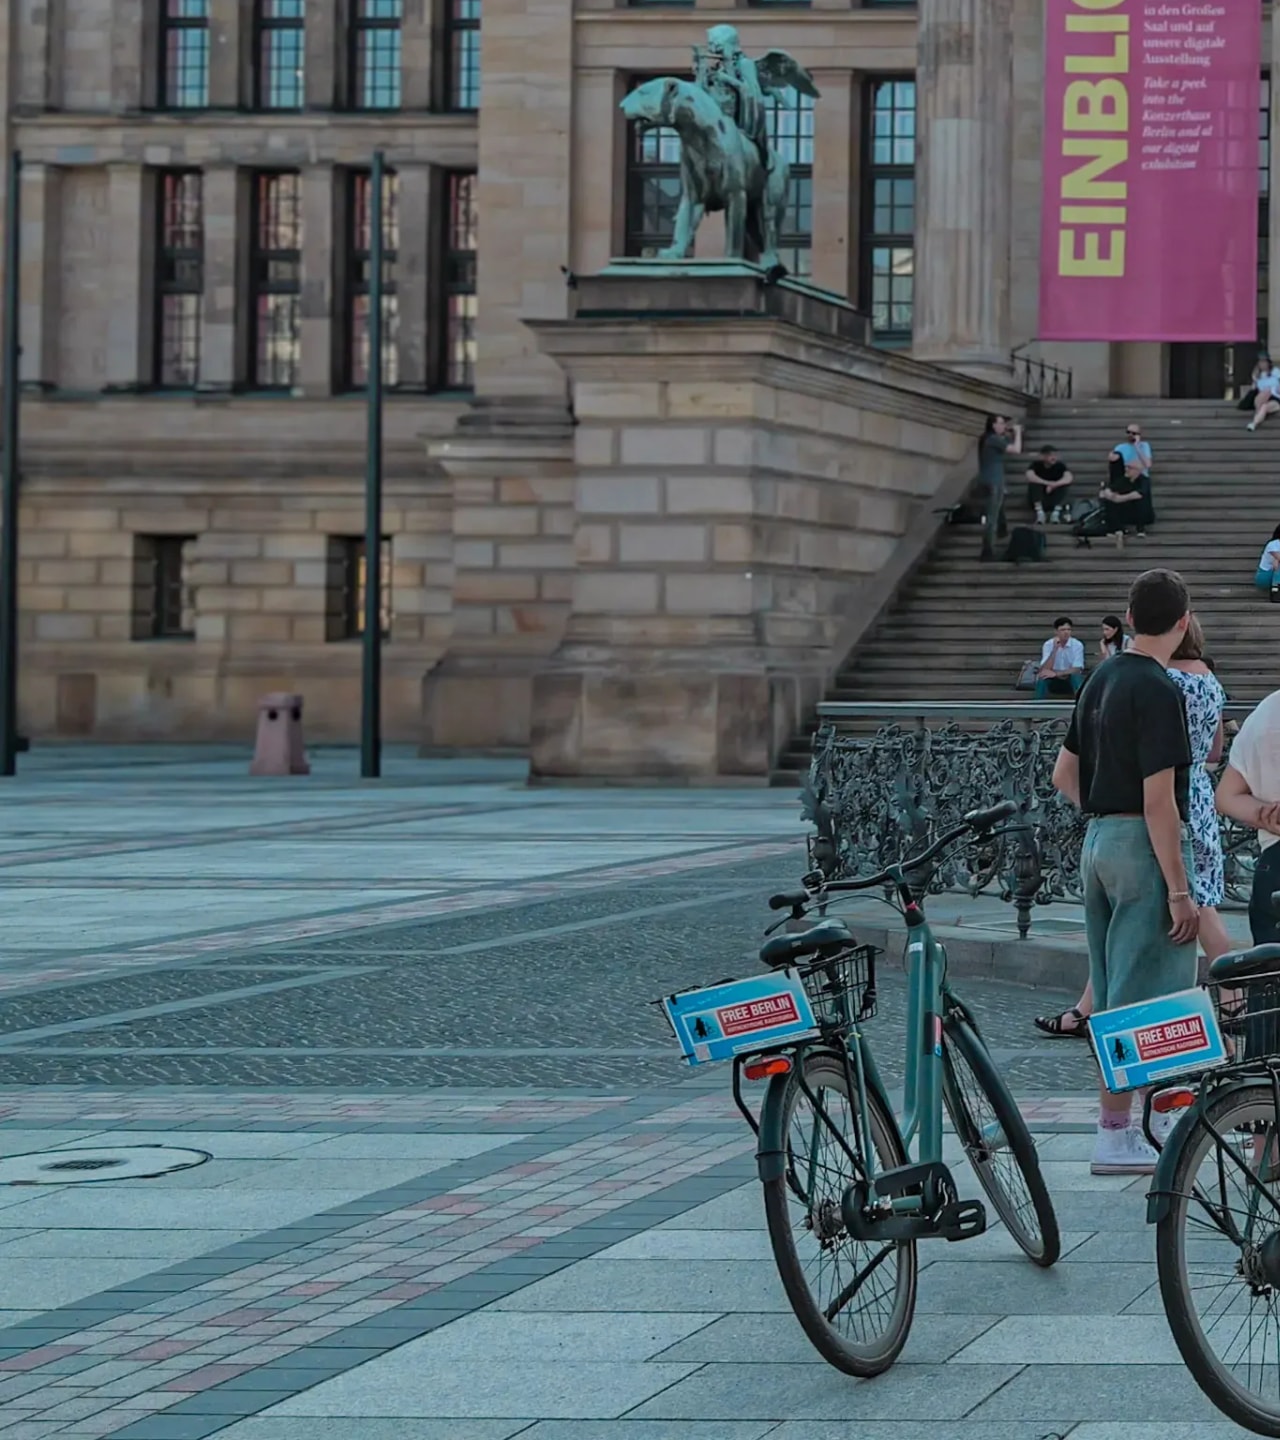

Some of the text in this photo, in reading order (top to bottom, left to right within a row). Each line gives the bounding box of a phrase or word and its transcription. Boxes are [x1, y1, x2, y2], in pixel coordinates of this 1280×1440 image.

[720, 1006, 749, 1023] FREE
[750, 997, 791, 1017] BERLIN
[1138, 1029, 1164, 1046] FREE
[1165, 1020, 1201, 1040] BERLIN
